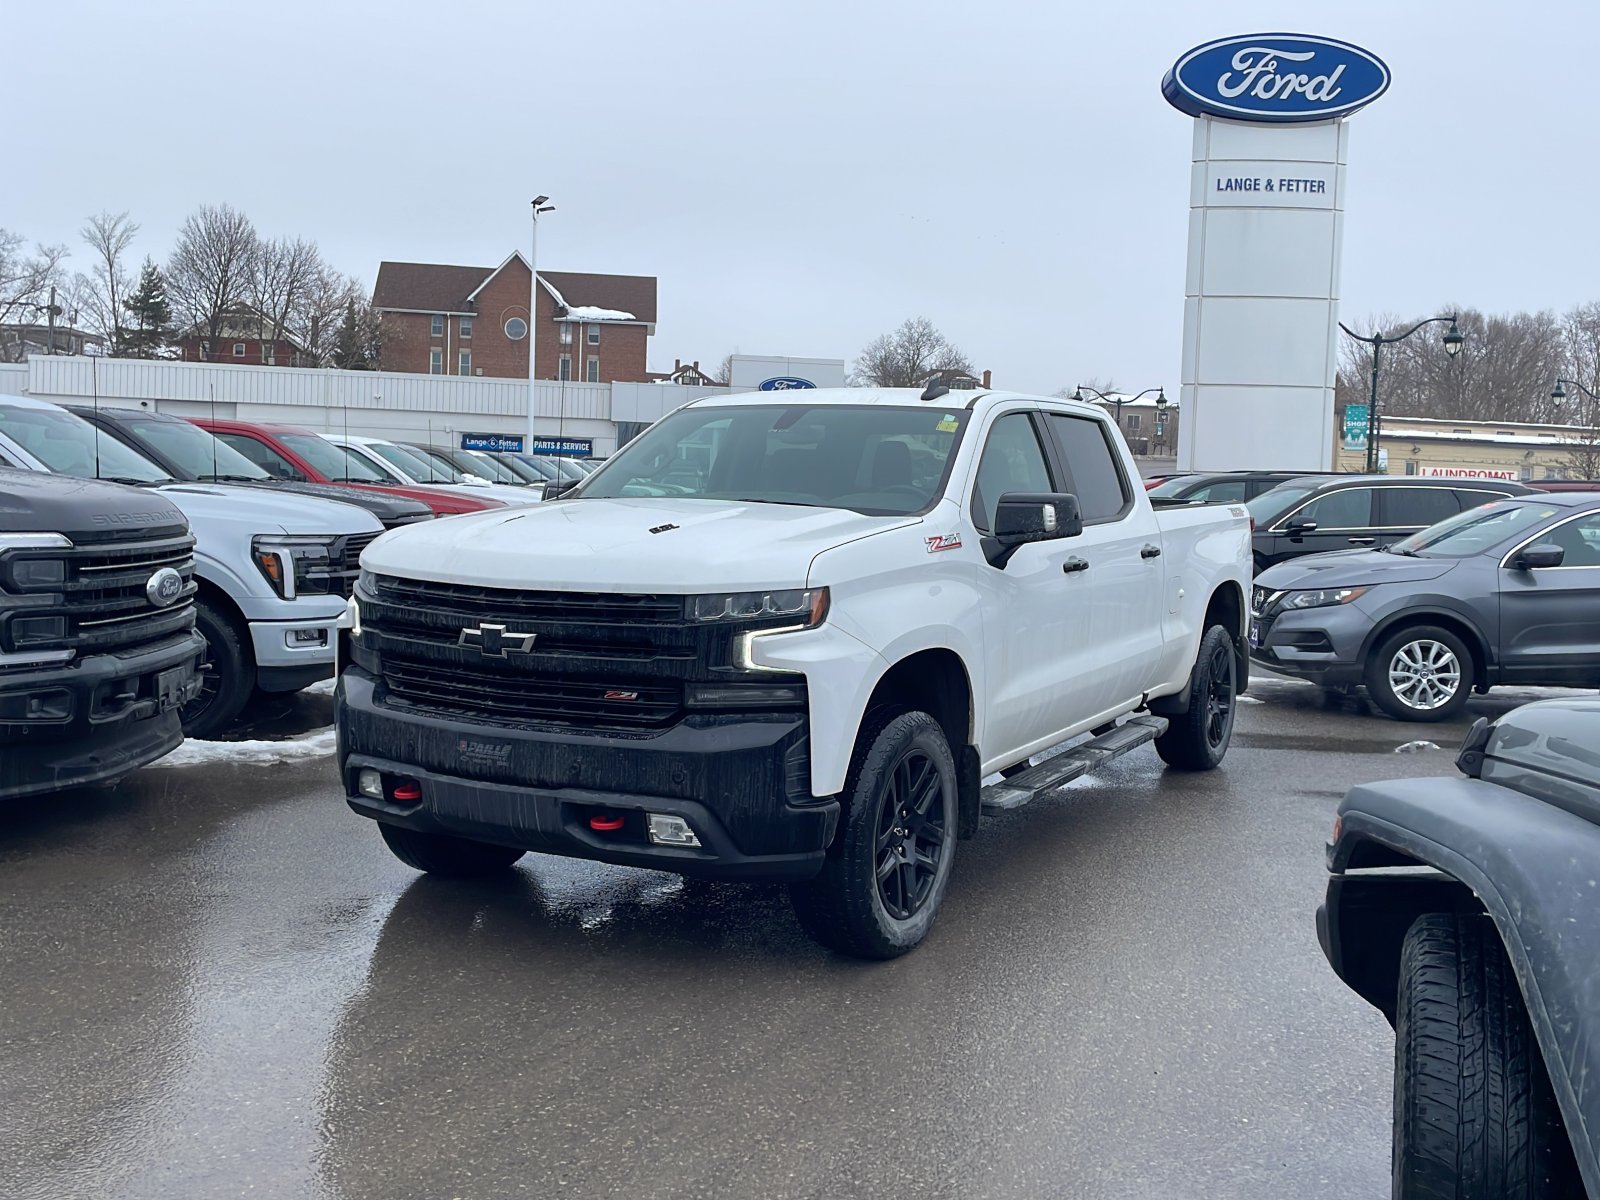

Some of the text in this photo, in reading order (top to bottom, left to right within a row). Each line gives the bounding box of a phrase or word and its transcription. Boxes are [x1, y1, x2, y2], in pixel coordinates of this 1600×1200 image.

[1217, 46, 1347, 102] Ford
[1216, 178, 1326, 194] LANGE & FETTER
[466, 438, 487, 447] Lange
[498, 439, 519, 447] Fetter
[534, 440, 590, 451] PARTS & SERVICE
[1422, 468, 1515, 480] LAUNDROMAT
[924, 533, 962, 553] Z71
[162, 578, 179, 597] Ford
[604, 690, 639, 700] Z71
